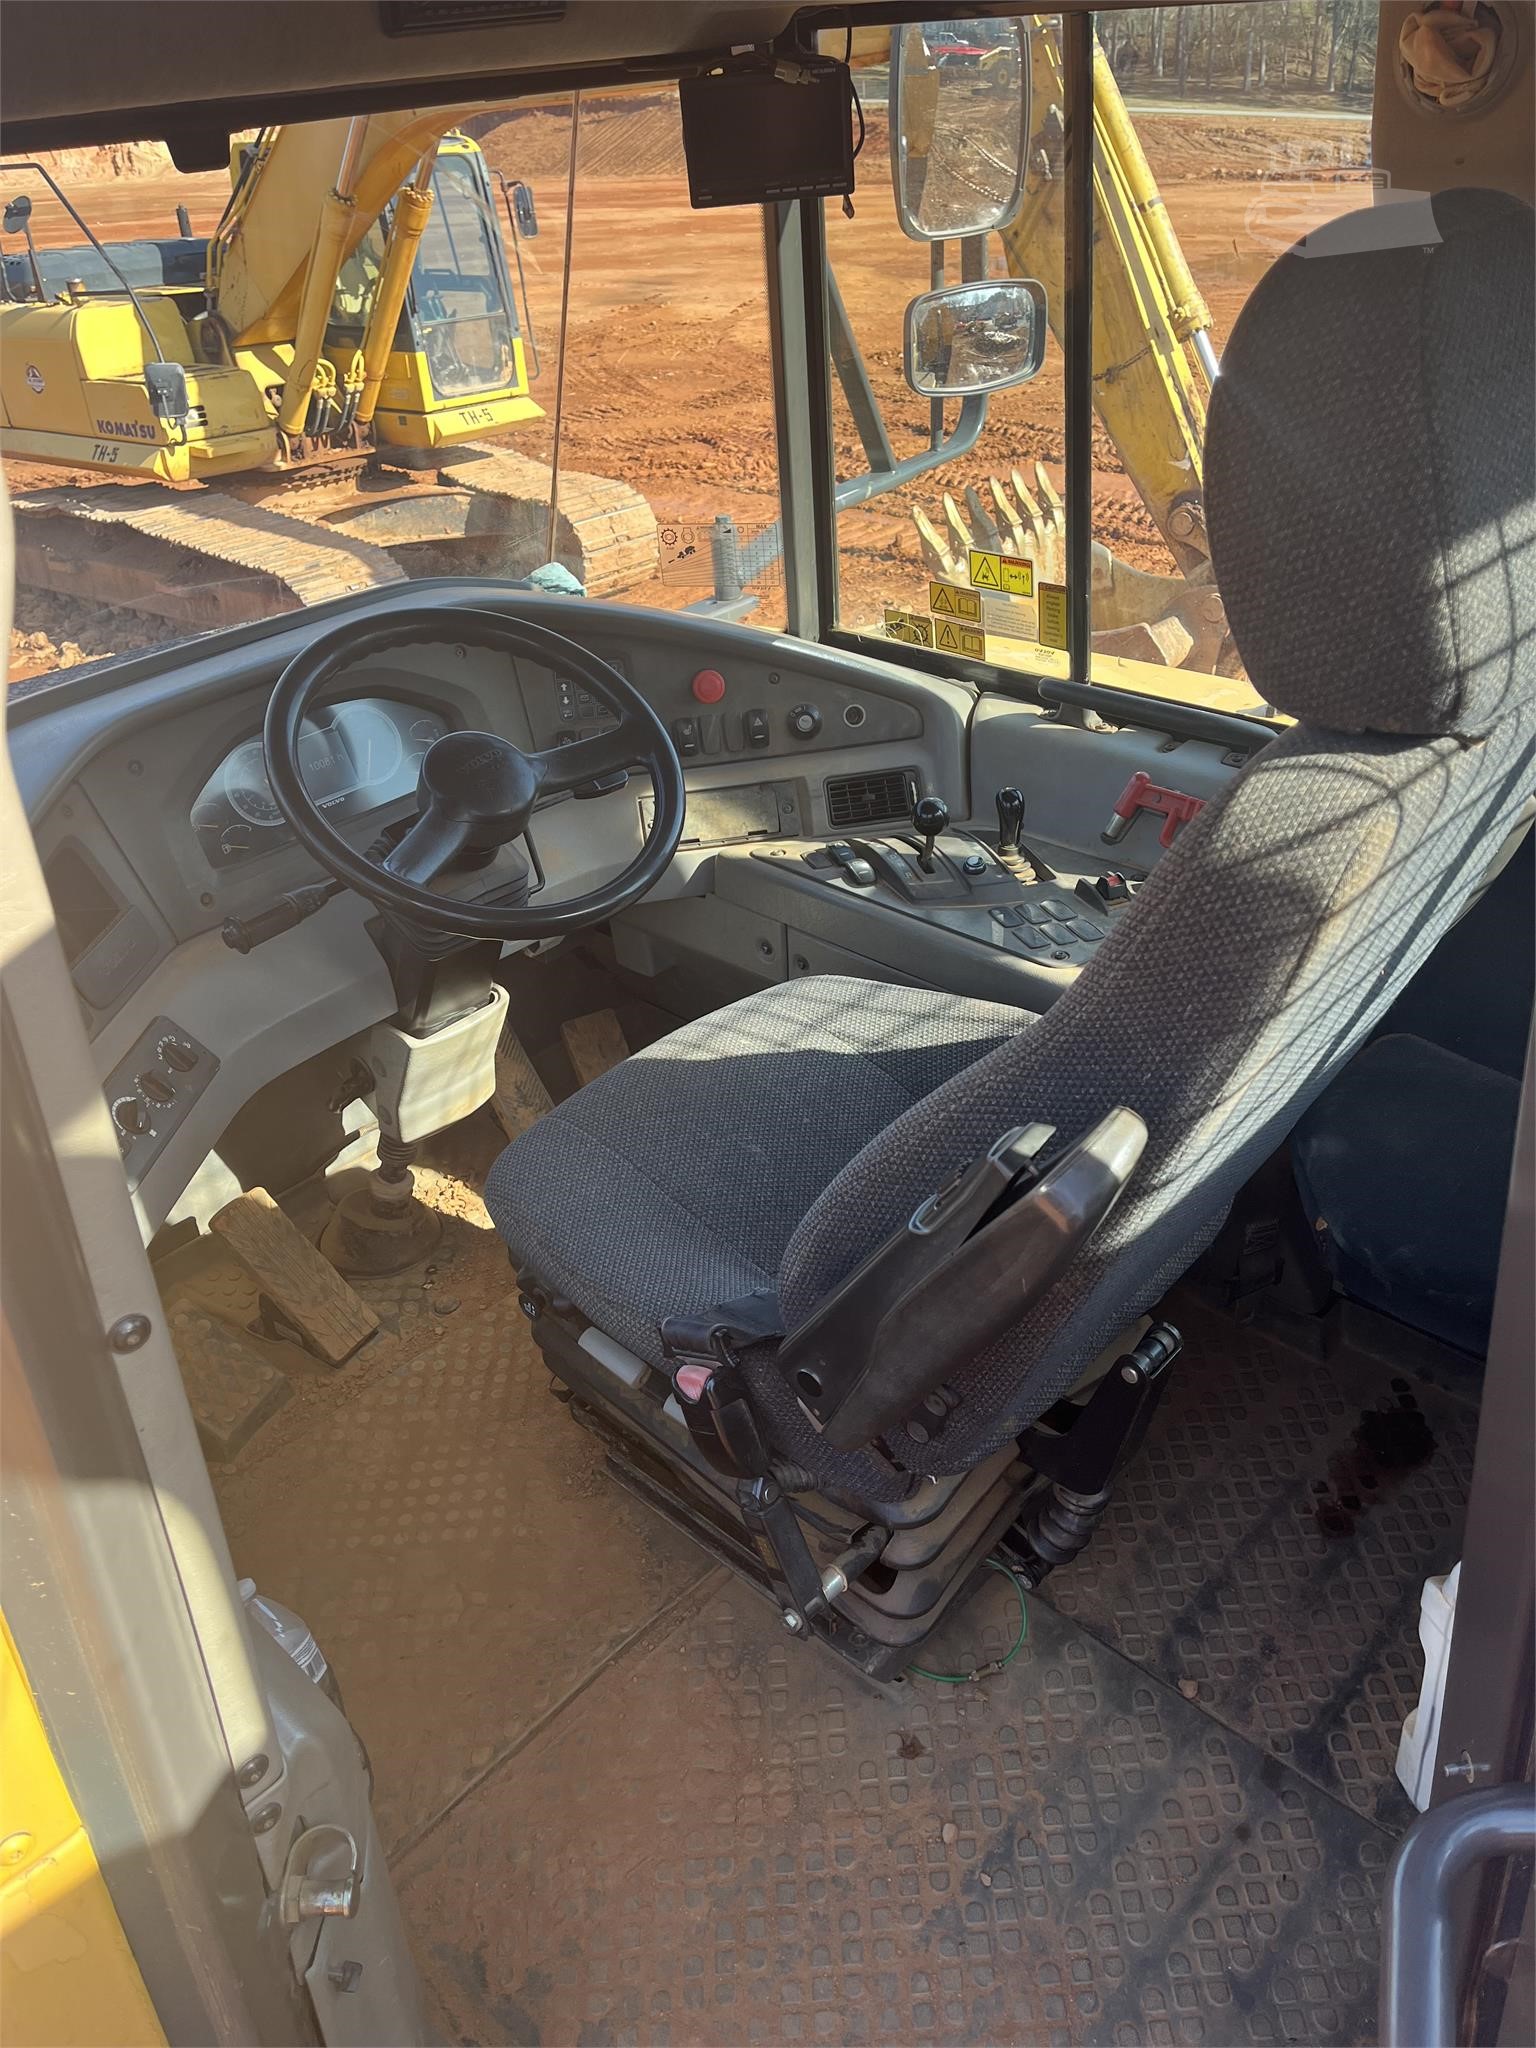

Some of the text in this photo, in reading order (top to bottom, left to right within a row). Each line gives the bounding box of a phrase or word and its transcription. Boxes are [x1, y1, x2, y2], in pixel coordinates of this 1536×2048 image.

[459, 408, 493, 425] TH-5
[97, 419, 156, 439] KOMATSU
[91, 444, 119, 463] TH-5
[321, 797, 345, 809] VOLVO
